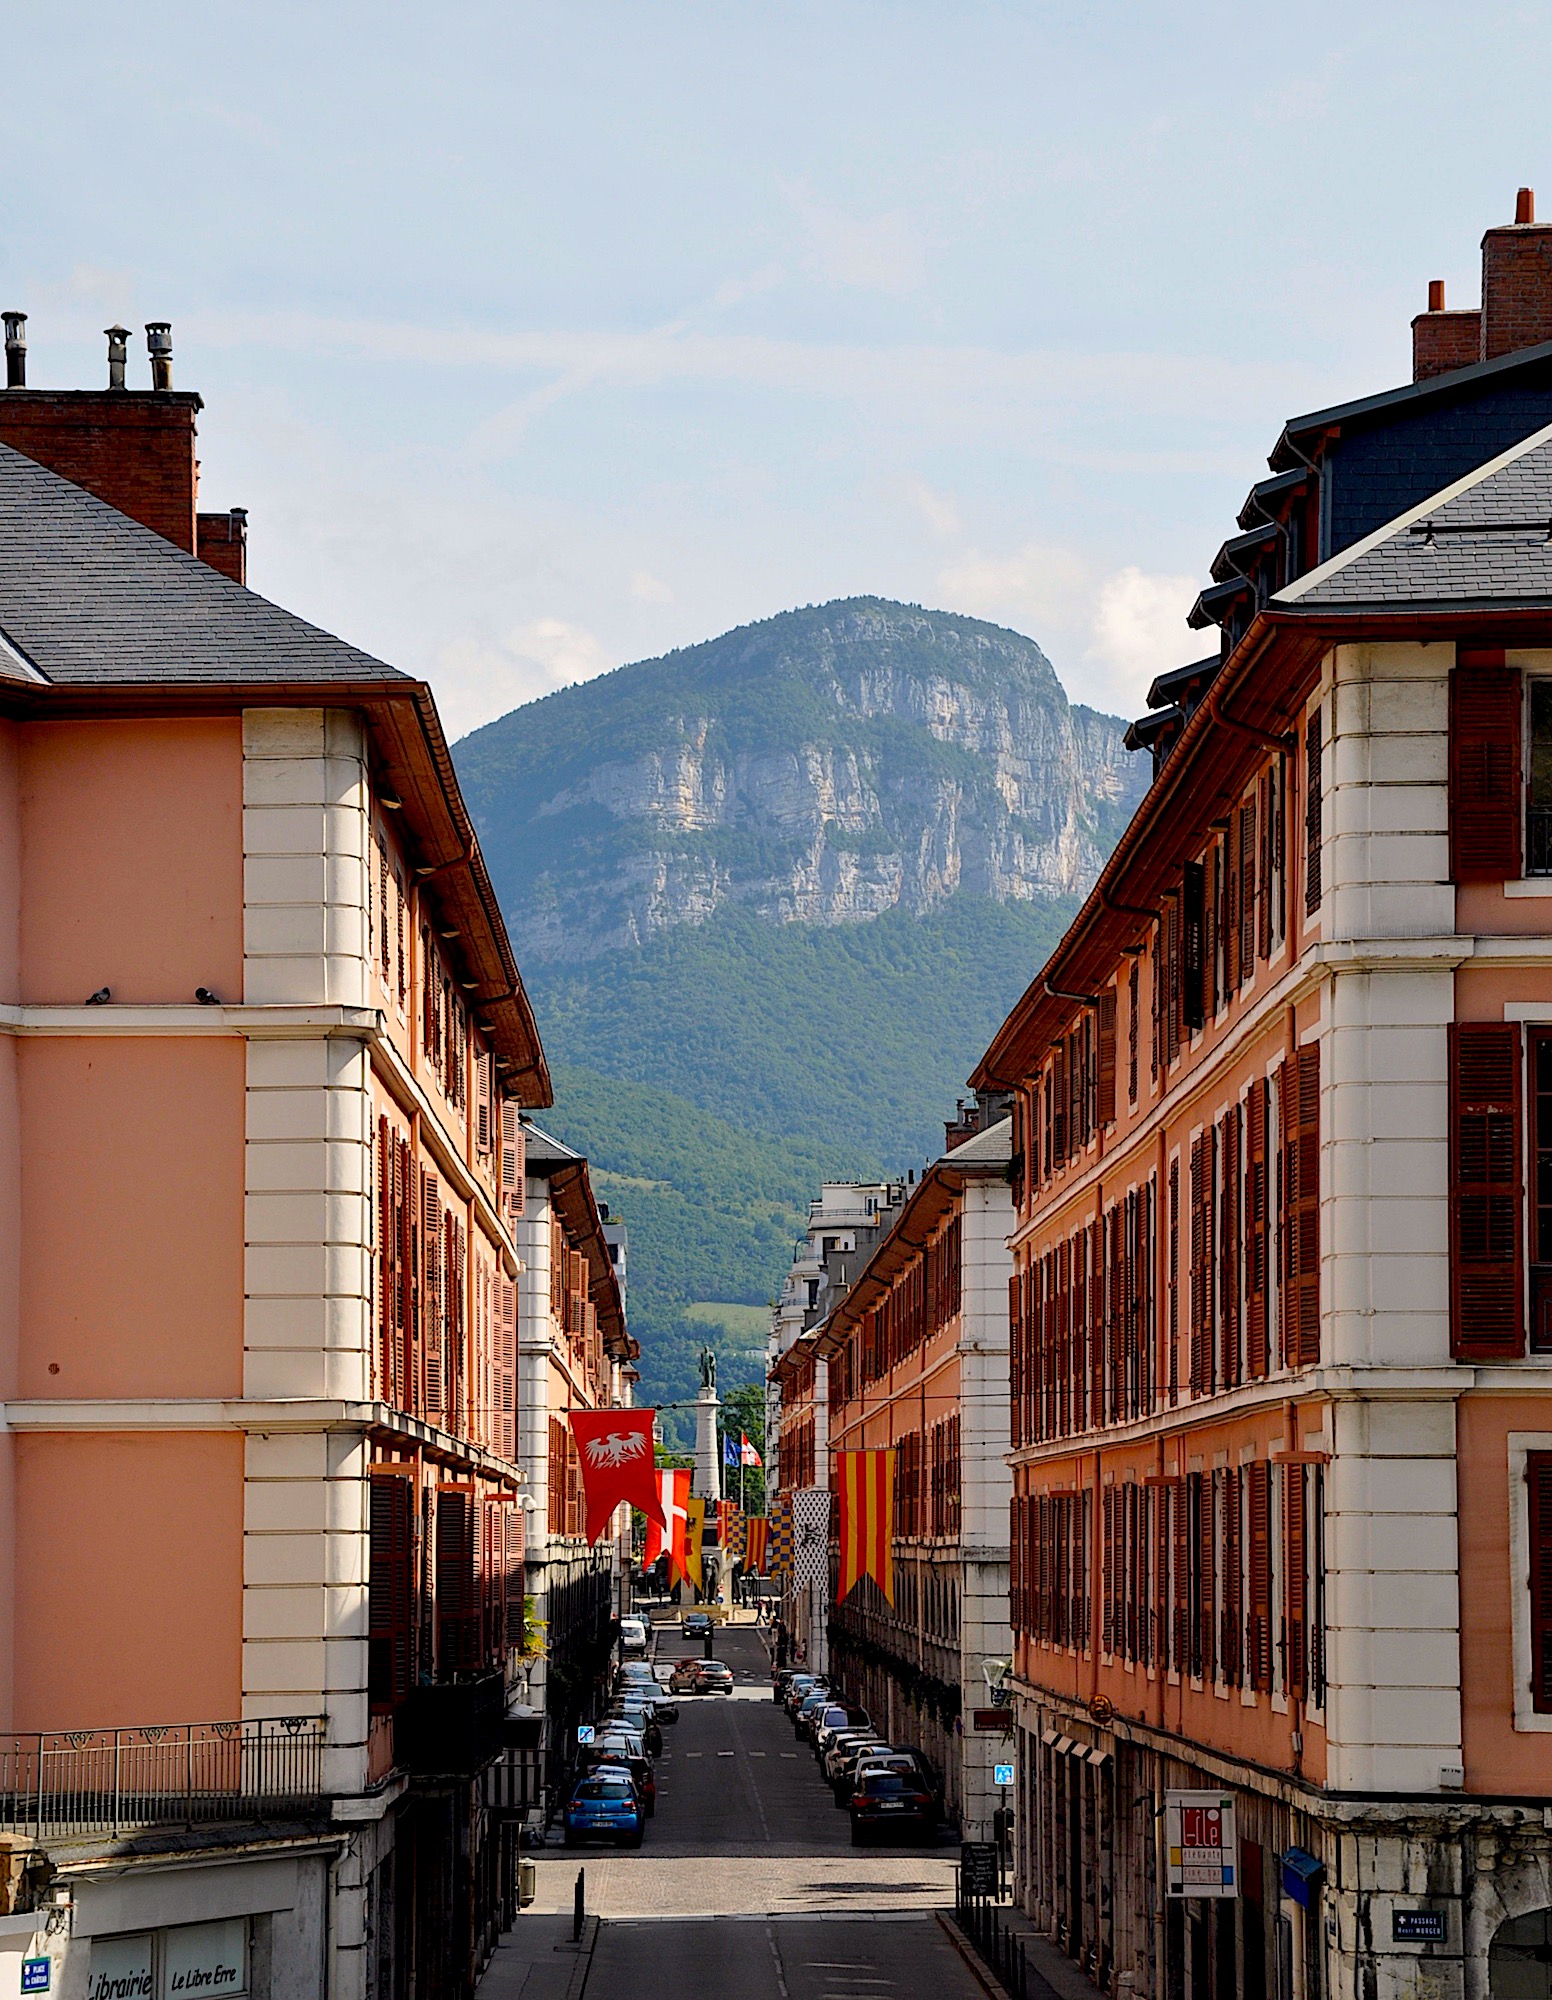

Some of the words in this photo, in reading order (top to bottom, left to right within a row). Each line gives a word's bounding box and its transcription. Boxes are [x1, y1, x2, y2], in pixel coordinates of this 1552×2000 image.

[1410, 1917, 1437, 1925] PASSAGE
[32, 1965, 46, 1974] PLACE
[171, 1971, 185, 1991] Le
[185, 1969, 212, 1988] Libre
[213, 1964, 237, 1985] Erre
[88, 1969, 152, 2000] Librairie
